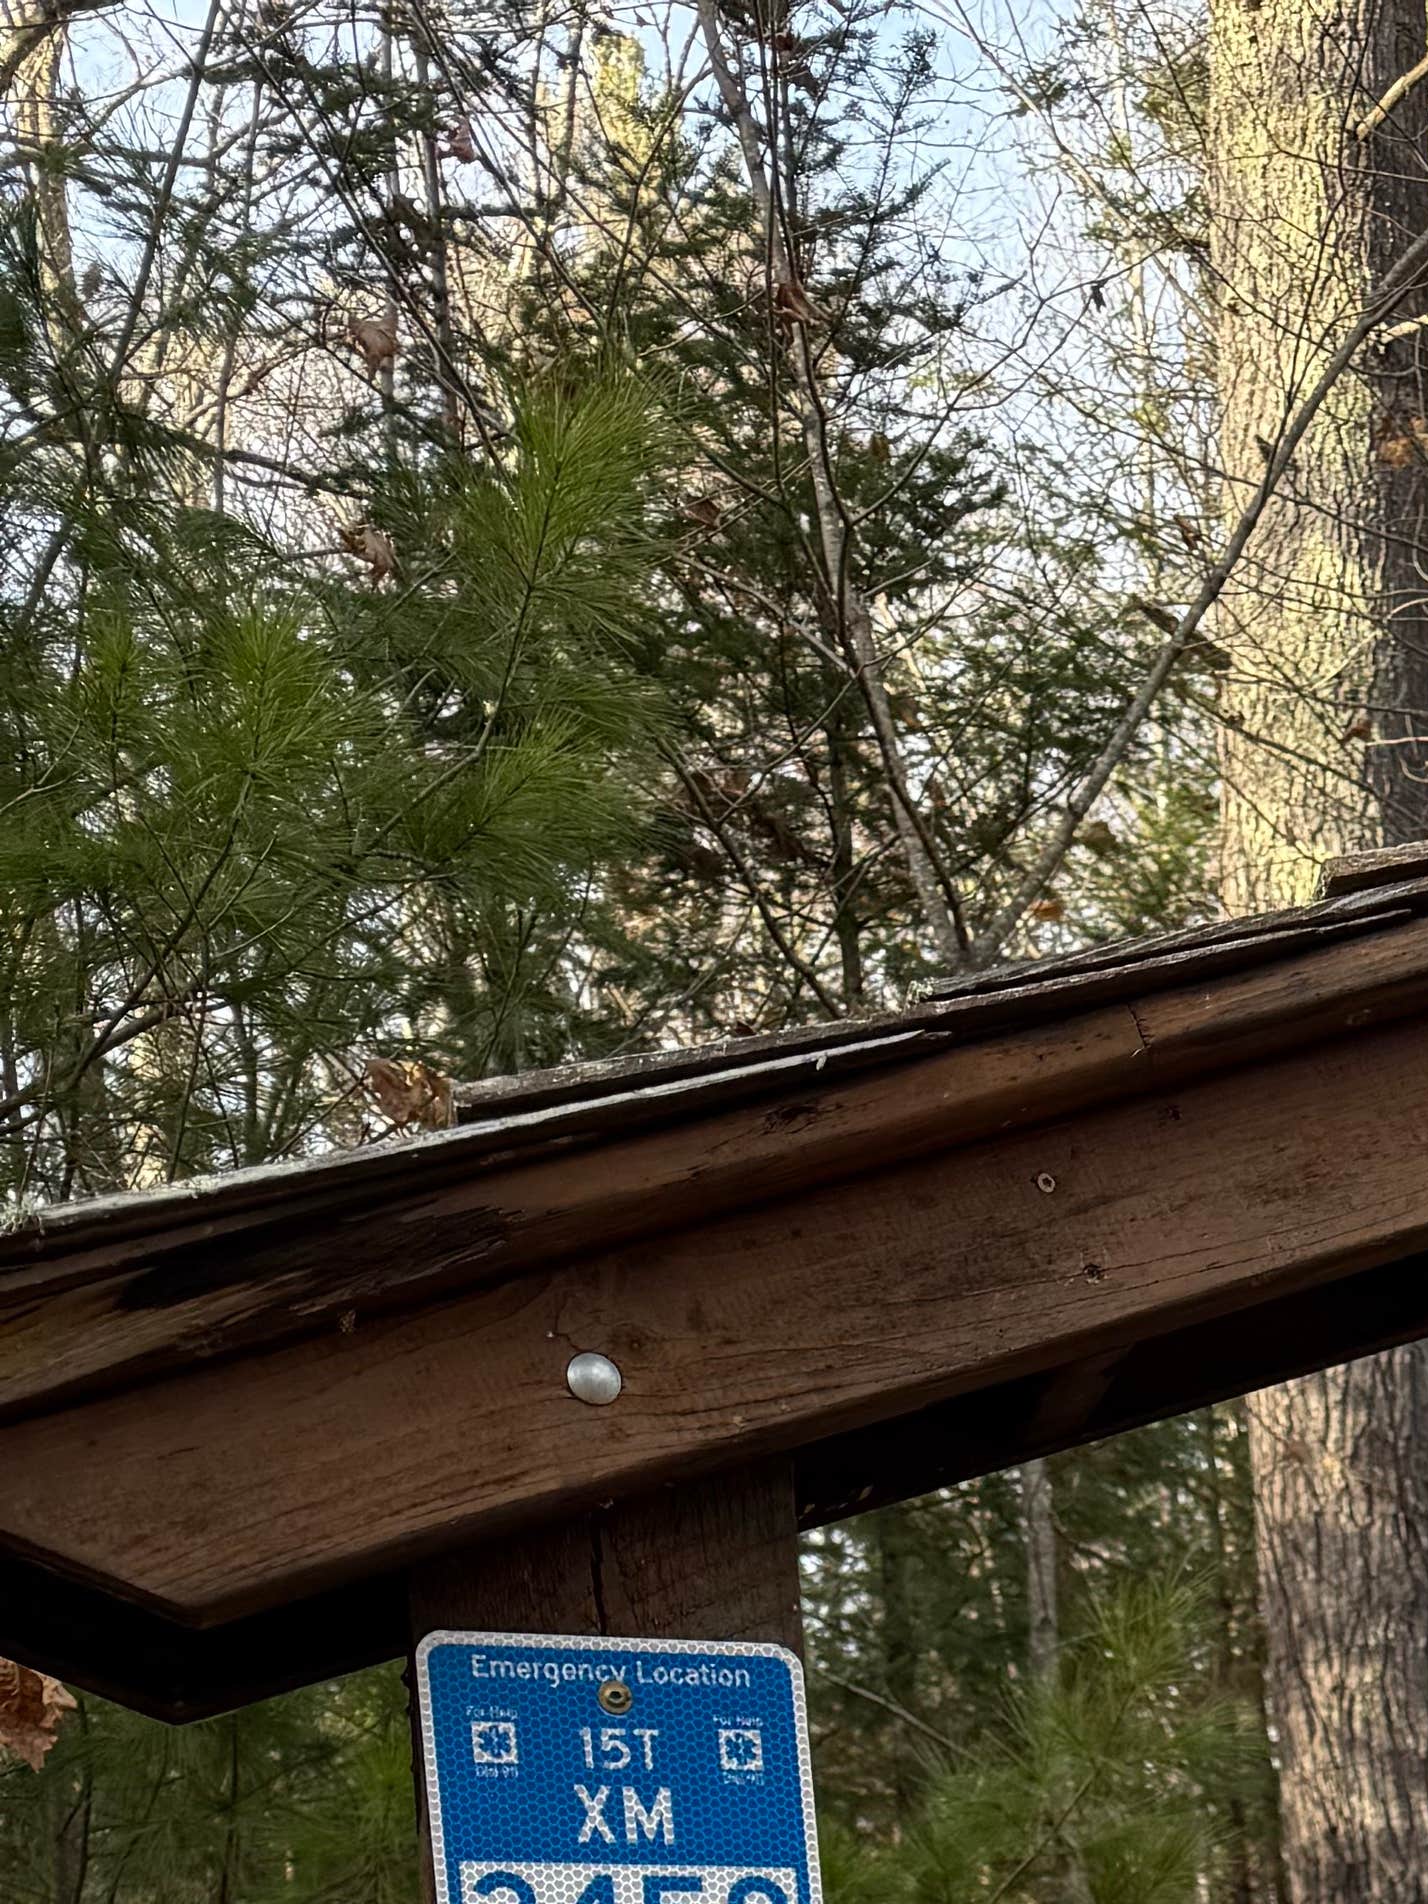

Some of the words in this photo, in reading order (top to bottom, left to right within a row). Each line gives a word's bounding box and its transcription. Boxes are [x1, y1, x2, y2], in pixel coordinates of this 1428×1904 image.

[471, 1654, 625, 1688] Emergency
[636, 1661, 750, 1687] Location
[580, 1727, 659, 1771] 15T
[574, 1784, 675, 1845] XM
